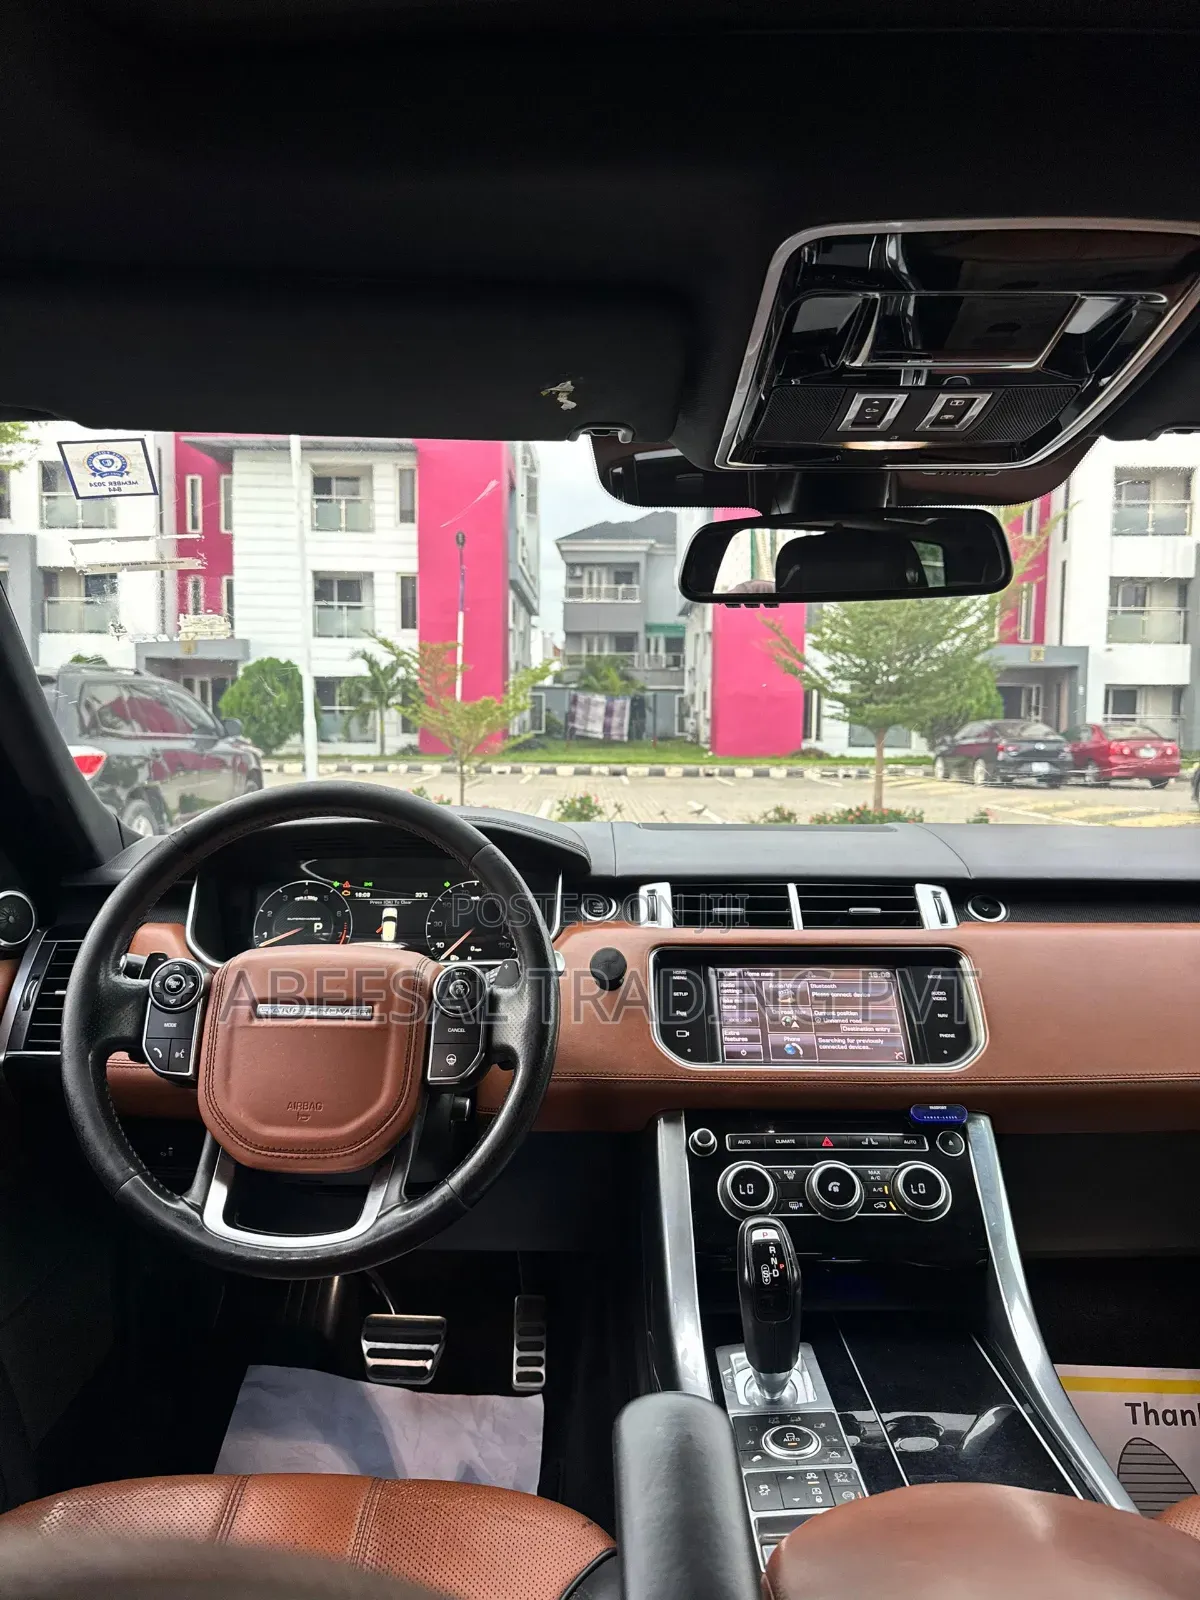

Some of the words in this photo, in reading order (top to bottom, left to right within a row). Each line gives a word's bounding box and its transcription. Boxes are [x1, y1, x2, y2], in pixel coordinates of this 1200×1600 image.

[314, 922, 323, 933] P
[317, 1006, 371, 1017] ROVER
[286, 1101, 323, 1112] AIRBAG
[768, 1246, 776, 1254] R
[770, 1257, 778, 1265] N
[772, 1269, 779, 1277] D
[1124, 1401, 1200, 1427] Than
